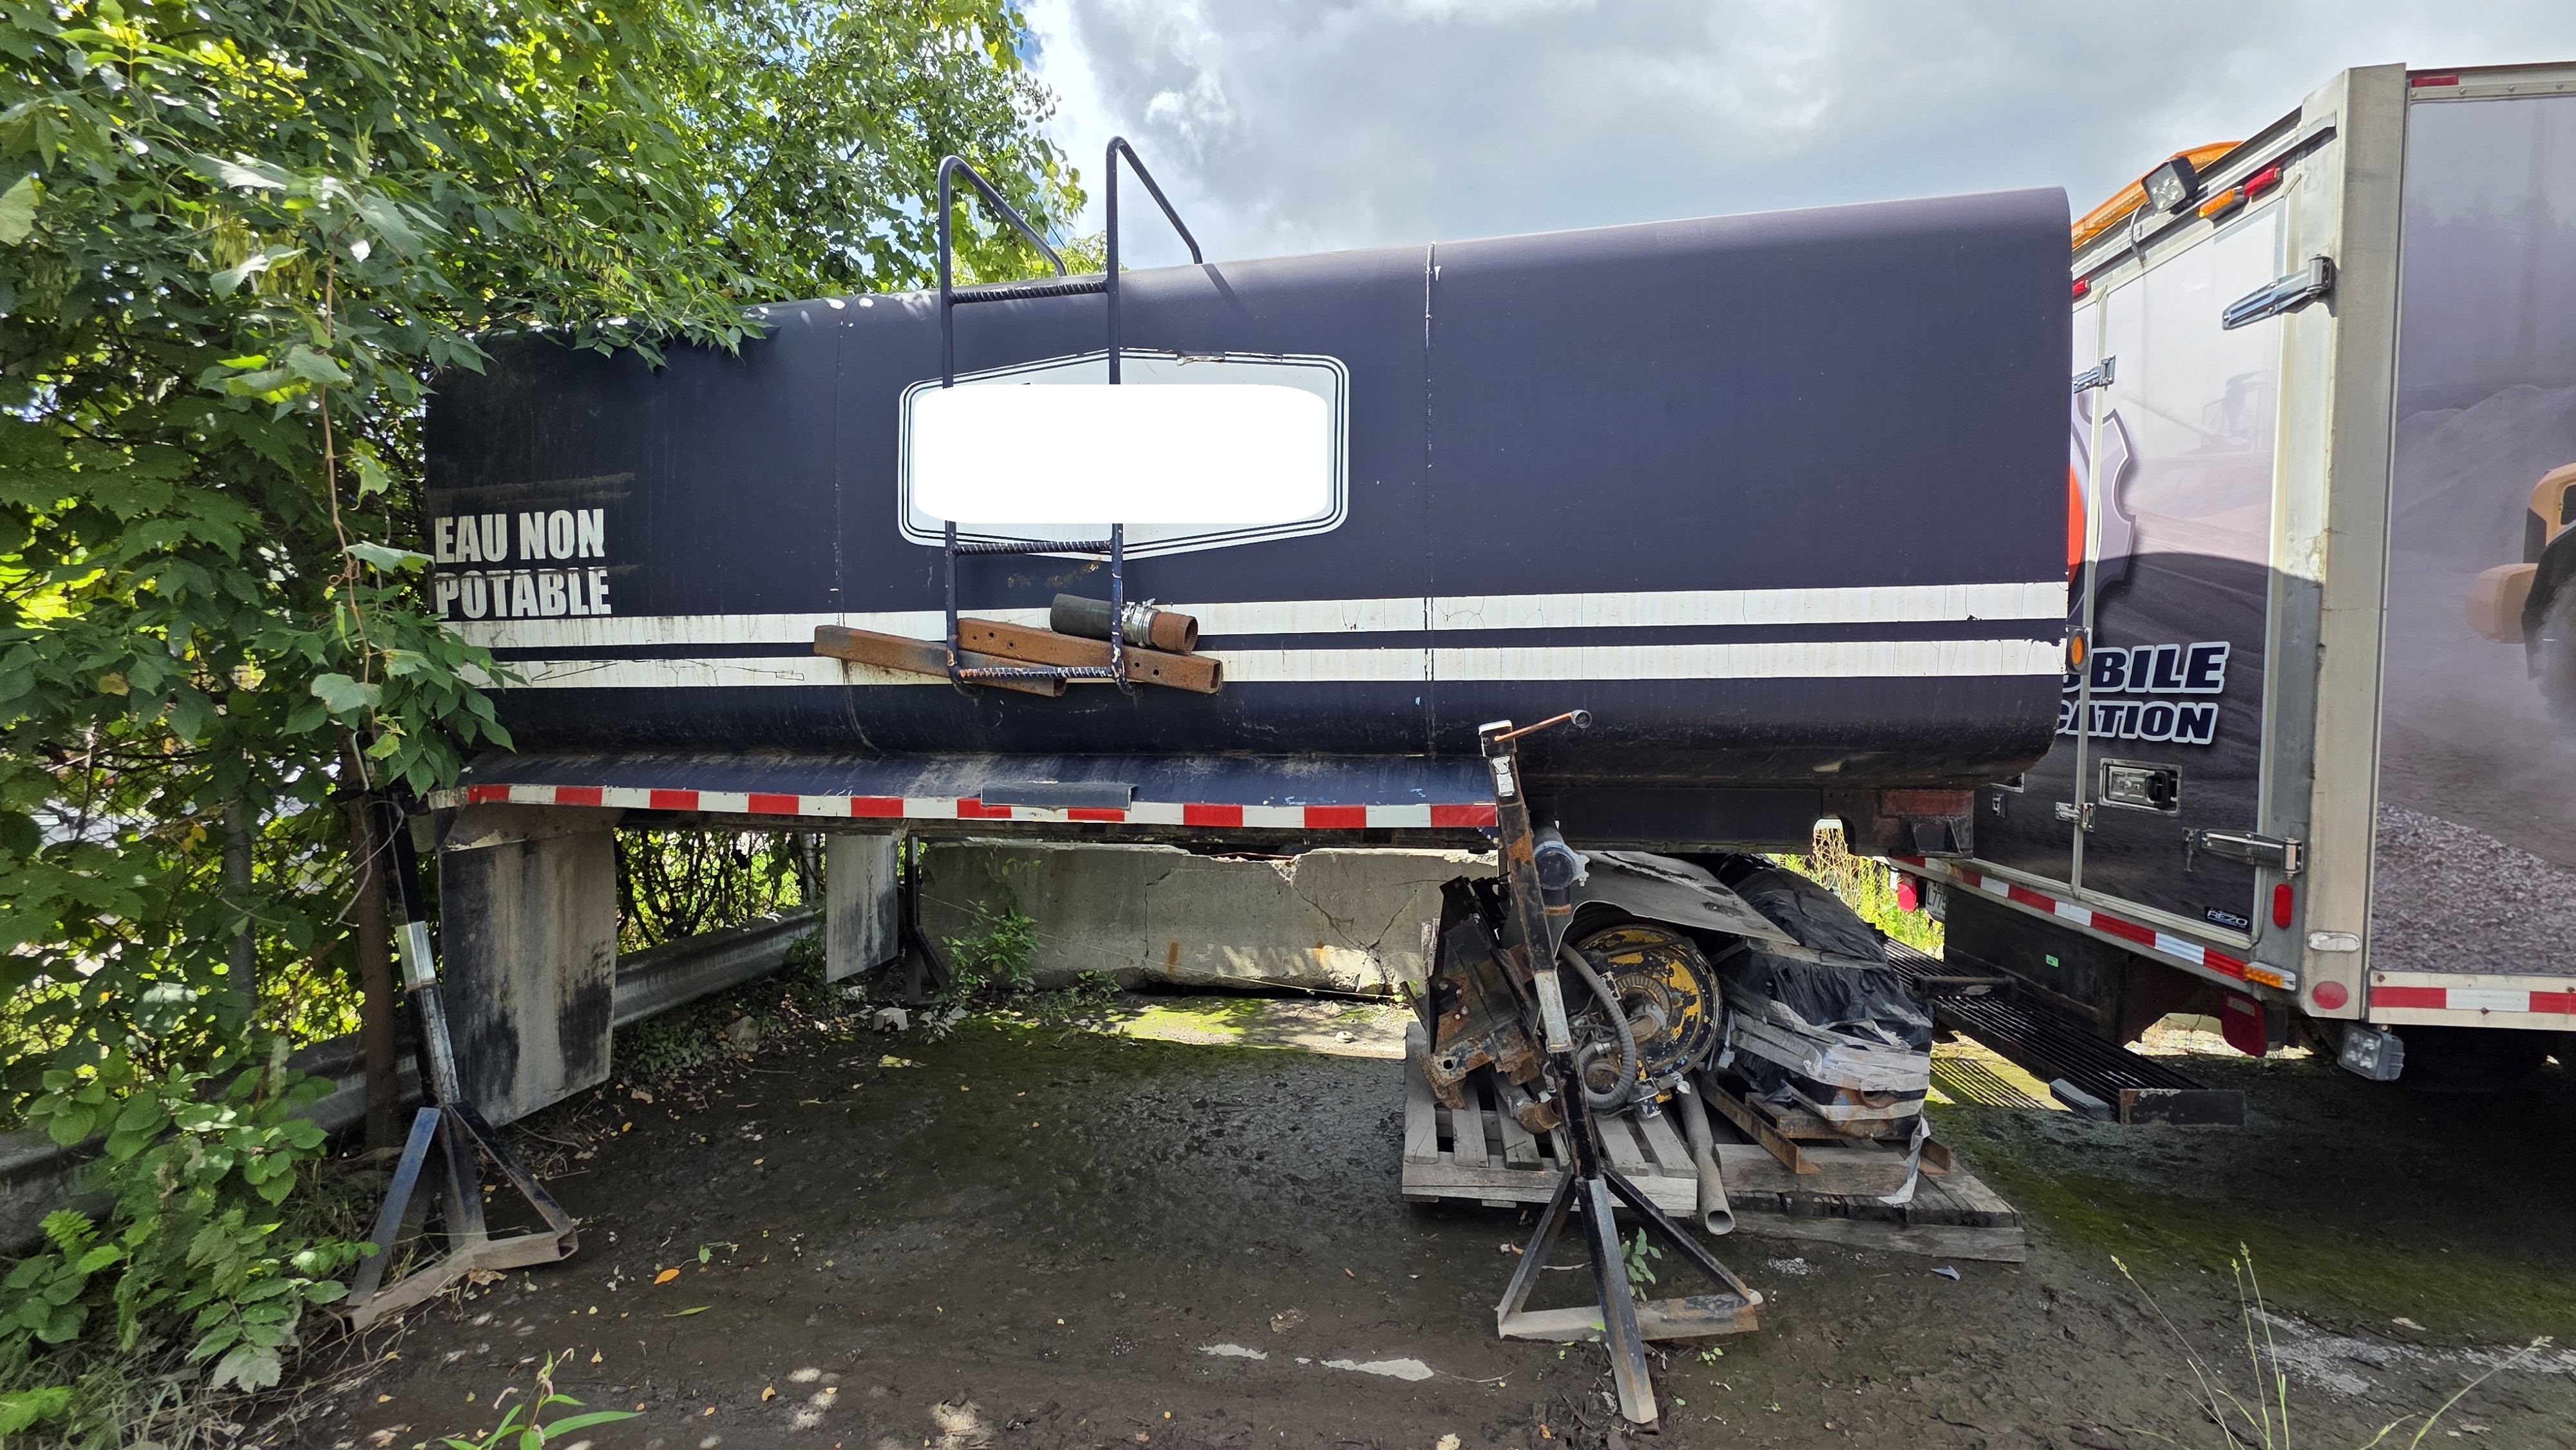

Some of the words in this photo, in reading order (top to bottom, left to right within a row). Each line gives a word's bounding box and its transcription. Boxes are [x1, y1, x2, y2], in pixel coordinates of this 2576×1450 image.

[435, 514, 507, 563] EAU
[519, 509, 605, 560] NON
[435, 567, 612, 619] POTABLE
